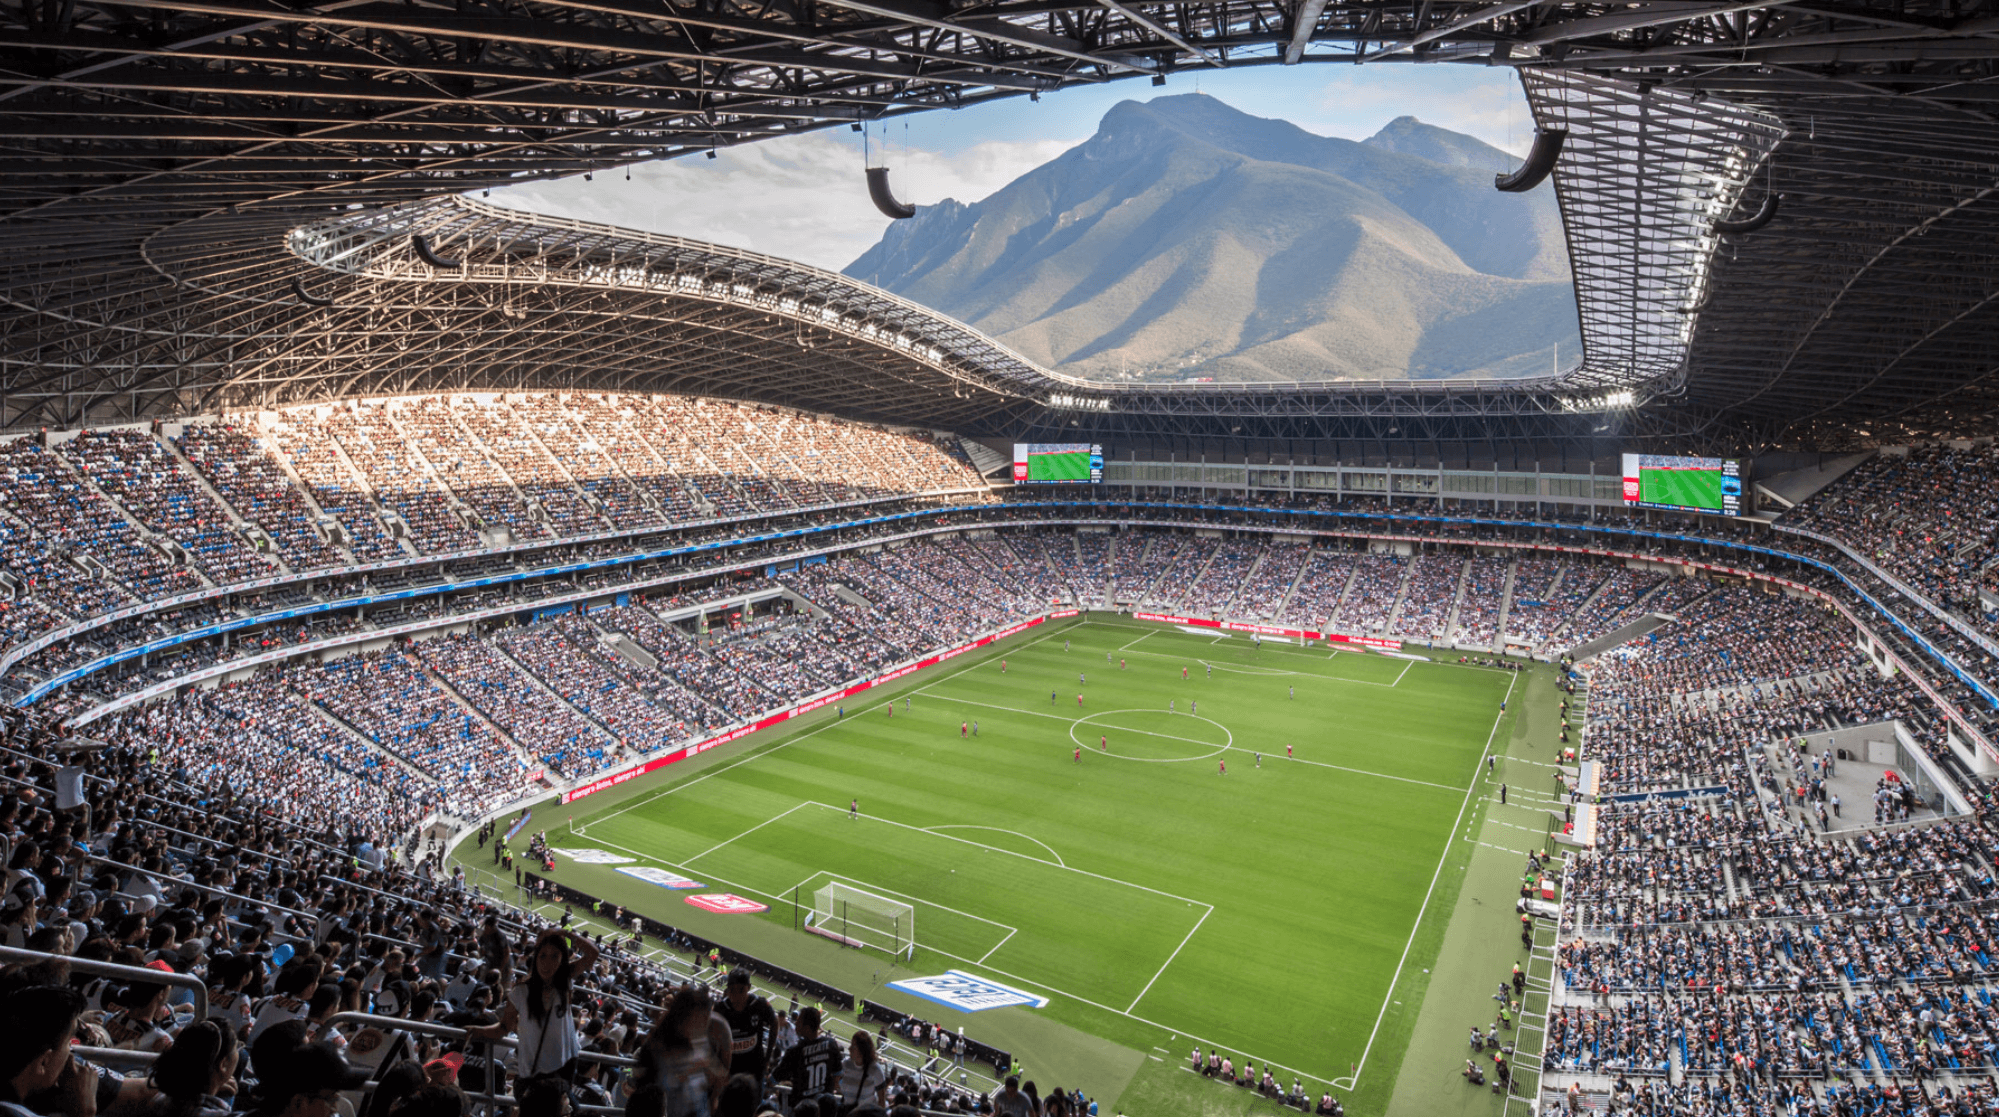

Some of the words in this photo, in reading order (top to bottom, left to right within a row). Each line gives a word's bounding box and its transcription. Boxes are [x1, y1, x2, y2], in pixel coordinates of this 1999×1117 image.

[731, 1037, 755, 1050] MBO
[803, 1040, 829, 1056] TECATE
[806, 1062, 827, 1090] 10
